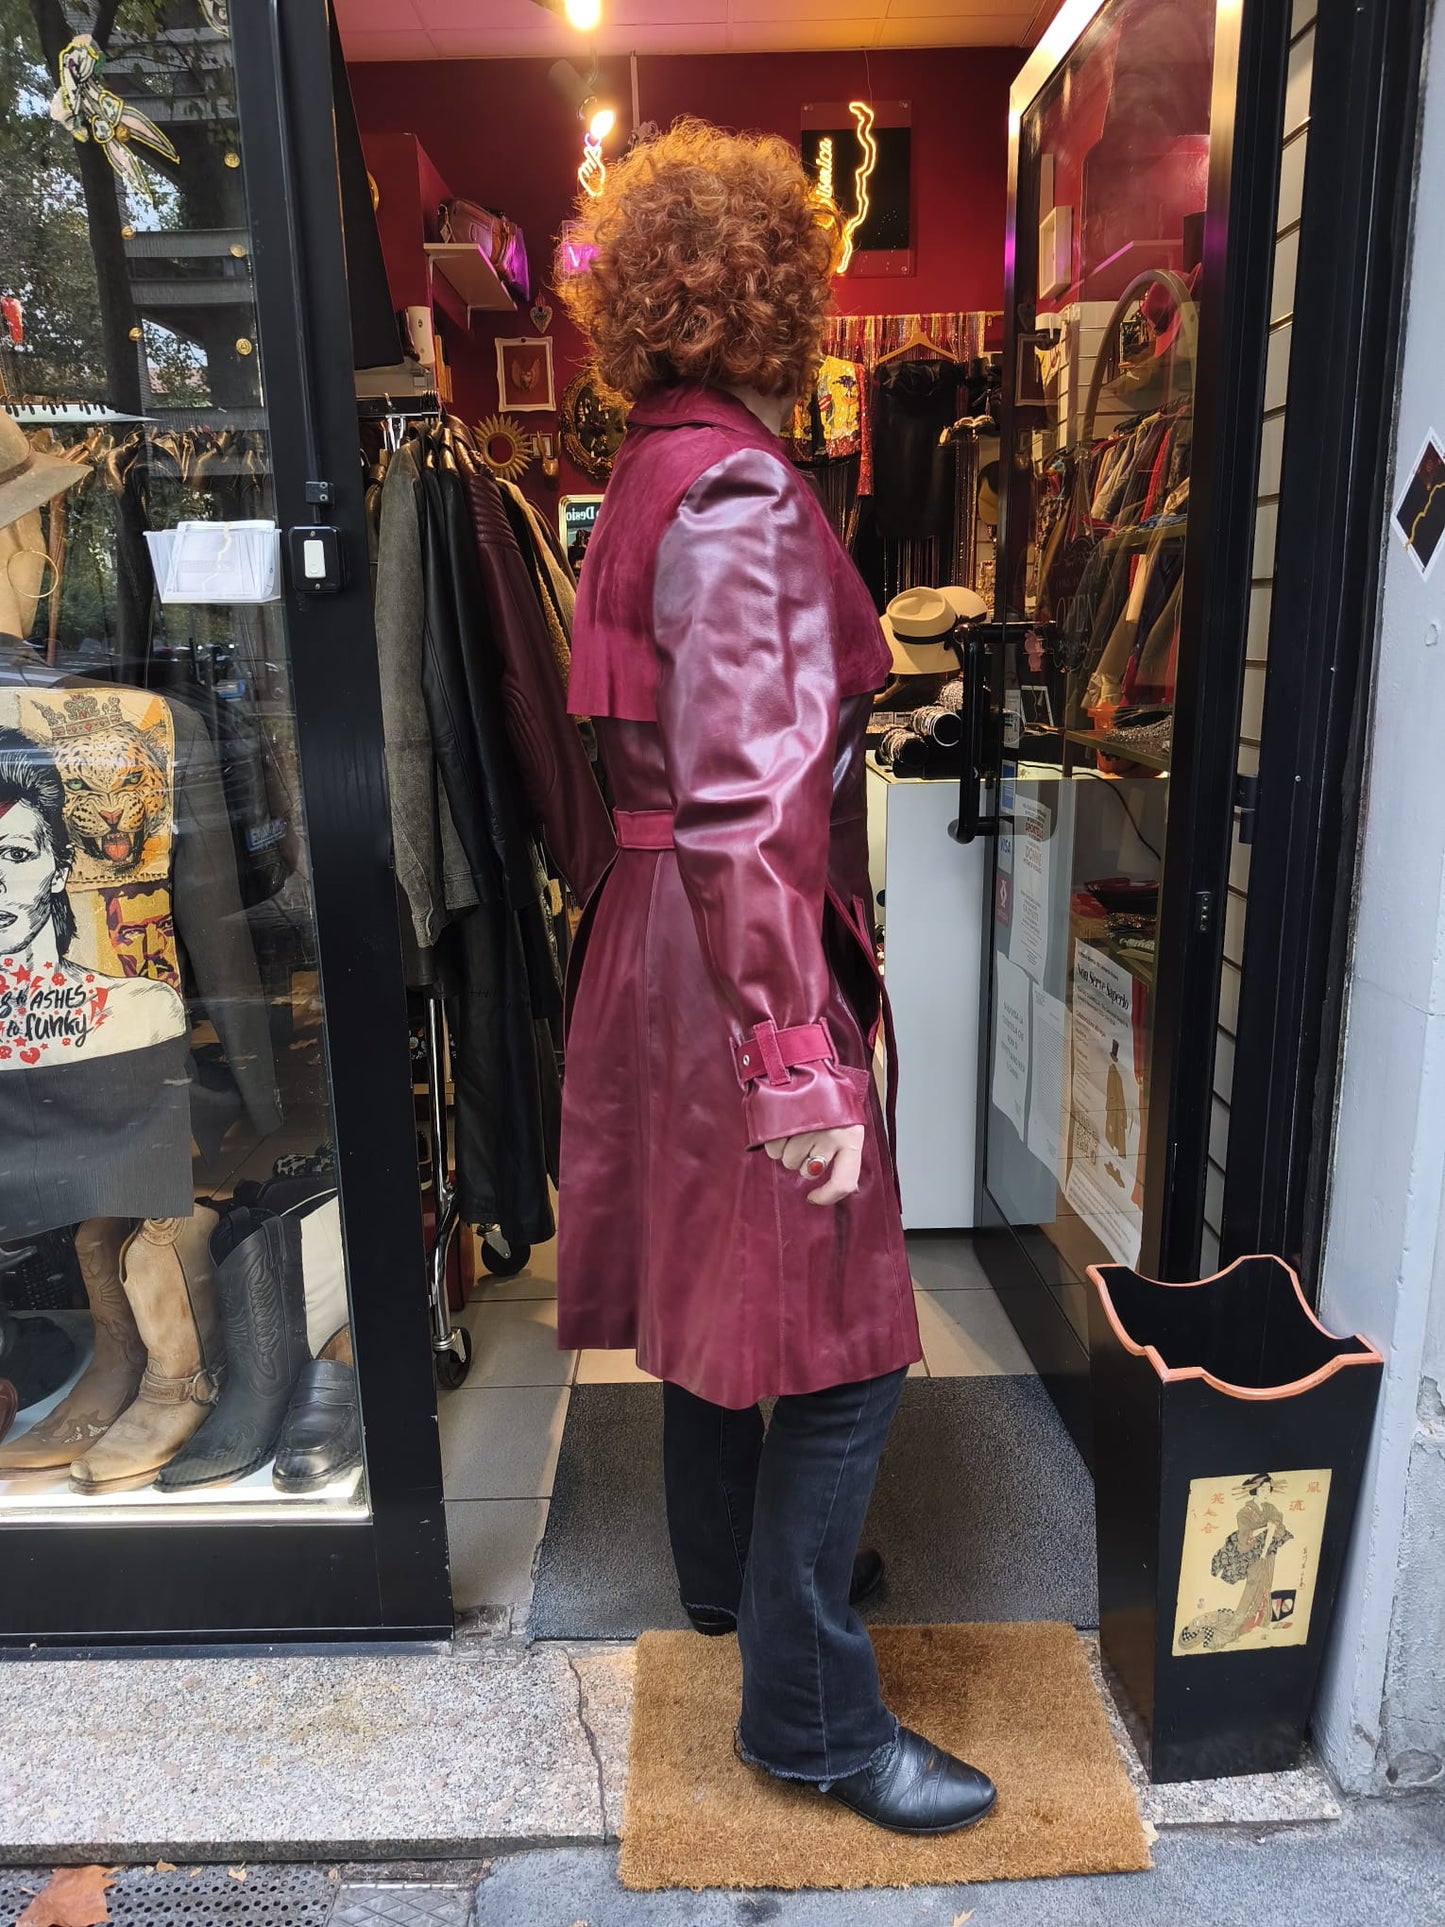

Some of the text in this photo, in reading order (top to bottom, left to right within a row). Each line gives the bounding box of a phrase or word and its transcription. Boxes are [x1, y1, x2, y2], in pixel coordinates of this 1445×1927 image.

[1000, 838, 1011, 853] VISA
[30, 984, 87, 1010] ASHES
[6, 1010, 94, 1047] to funky
